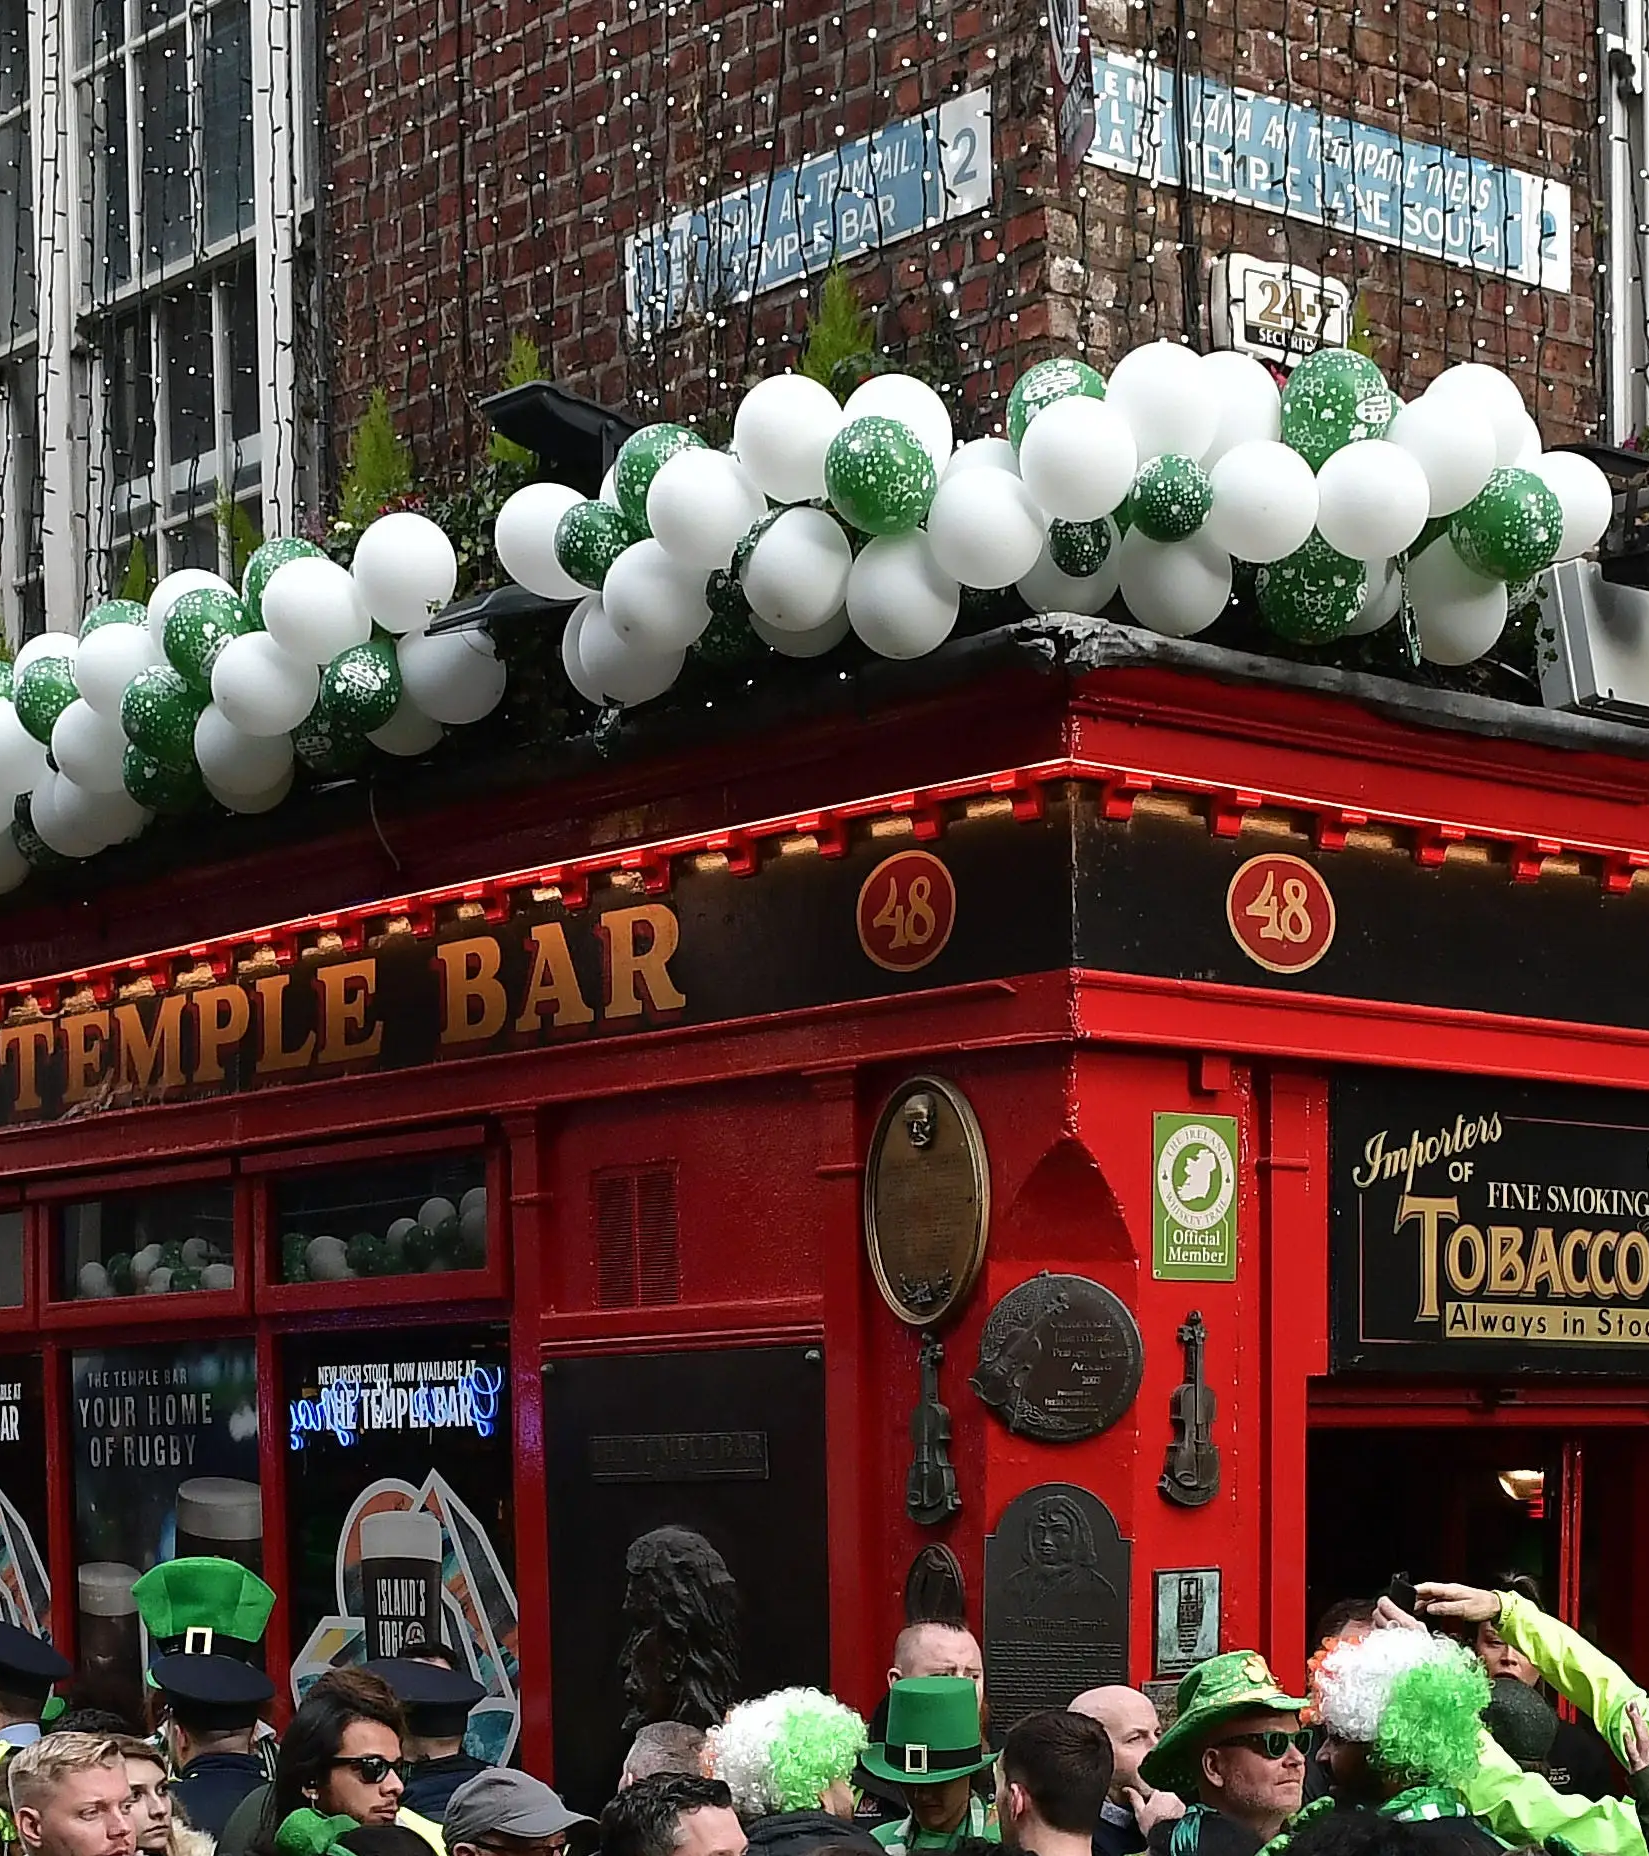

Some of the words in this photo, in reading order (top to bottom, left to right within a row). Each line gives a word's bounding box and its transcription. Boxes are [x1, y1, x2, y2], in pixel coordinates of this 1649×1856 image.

[1262, 114, 1295, 151] AN
[952, 126, 978, 187] 2
[779, 184, 807, 225] AN
[841, 195, 897, 241] BAR
[1189, 146, 1302, 201] TEMPLE
[1315, 173, 1390, 228] LANE
[1403, 203, 1500, 257] SOUTH
[1537, 209, 1558, 260] 2
[1258, 328, 1317, 353] SECURITY
[871, 874, 936, 951] 48
[1245, 869, 1311, 944] 48
[436, 902, 686, 1045] BAR
[1165, 1135, 1184, 1159] THE
[1185, 1128, 1229, 1162] IRELAND
[1352, 1111, 1502, 1193] Importers
[1448, 1161, 1474, 1182] OF
[1165, 1190, 1203, 1227] WHISKEY
[1204, 1200, 1227, 1226] TRAIL
[1487, 1182, 1541, 1211] FINE
[1167, 1246, 1225, 1264] Member
[1173, 1229, 1221, 1247] Official
[1450, 1303, 1547, 1337] Always
[1563, 1311, 1585, 1334] in
[87, 1371, 111, 1388] THE
[114, 1369, 160, 1387] TEMPLE
[163, 1367, 188, 1384] BAR
[318, 1366, 337, 1385] NEW
[394, 1362, 416, 1382] NOW
[416, 1360, 464, 1382] AVAILABLE
[465, 1359, 477, 1379] AT
[13, 1382, 21, 1400] AT
[326, 1386, 358, 1431] THE
[360, 1387, 429, 1430] TEMPLE
[433, 1384, 475, 1428] BAR
[79, 1395, 141, 1429] YOUR
[148, 1392, 214, 1426] HOME
[89, 1439, 115, 1468] OF
[121, 1433, 197, 1467] RUGBY
[376, 1576, 427, 1617] ISLAND'S
[376, 1619, 405, 1660] EDGE
